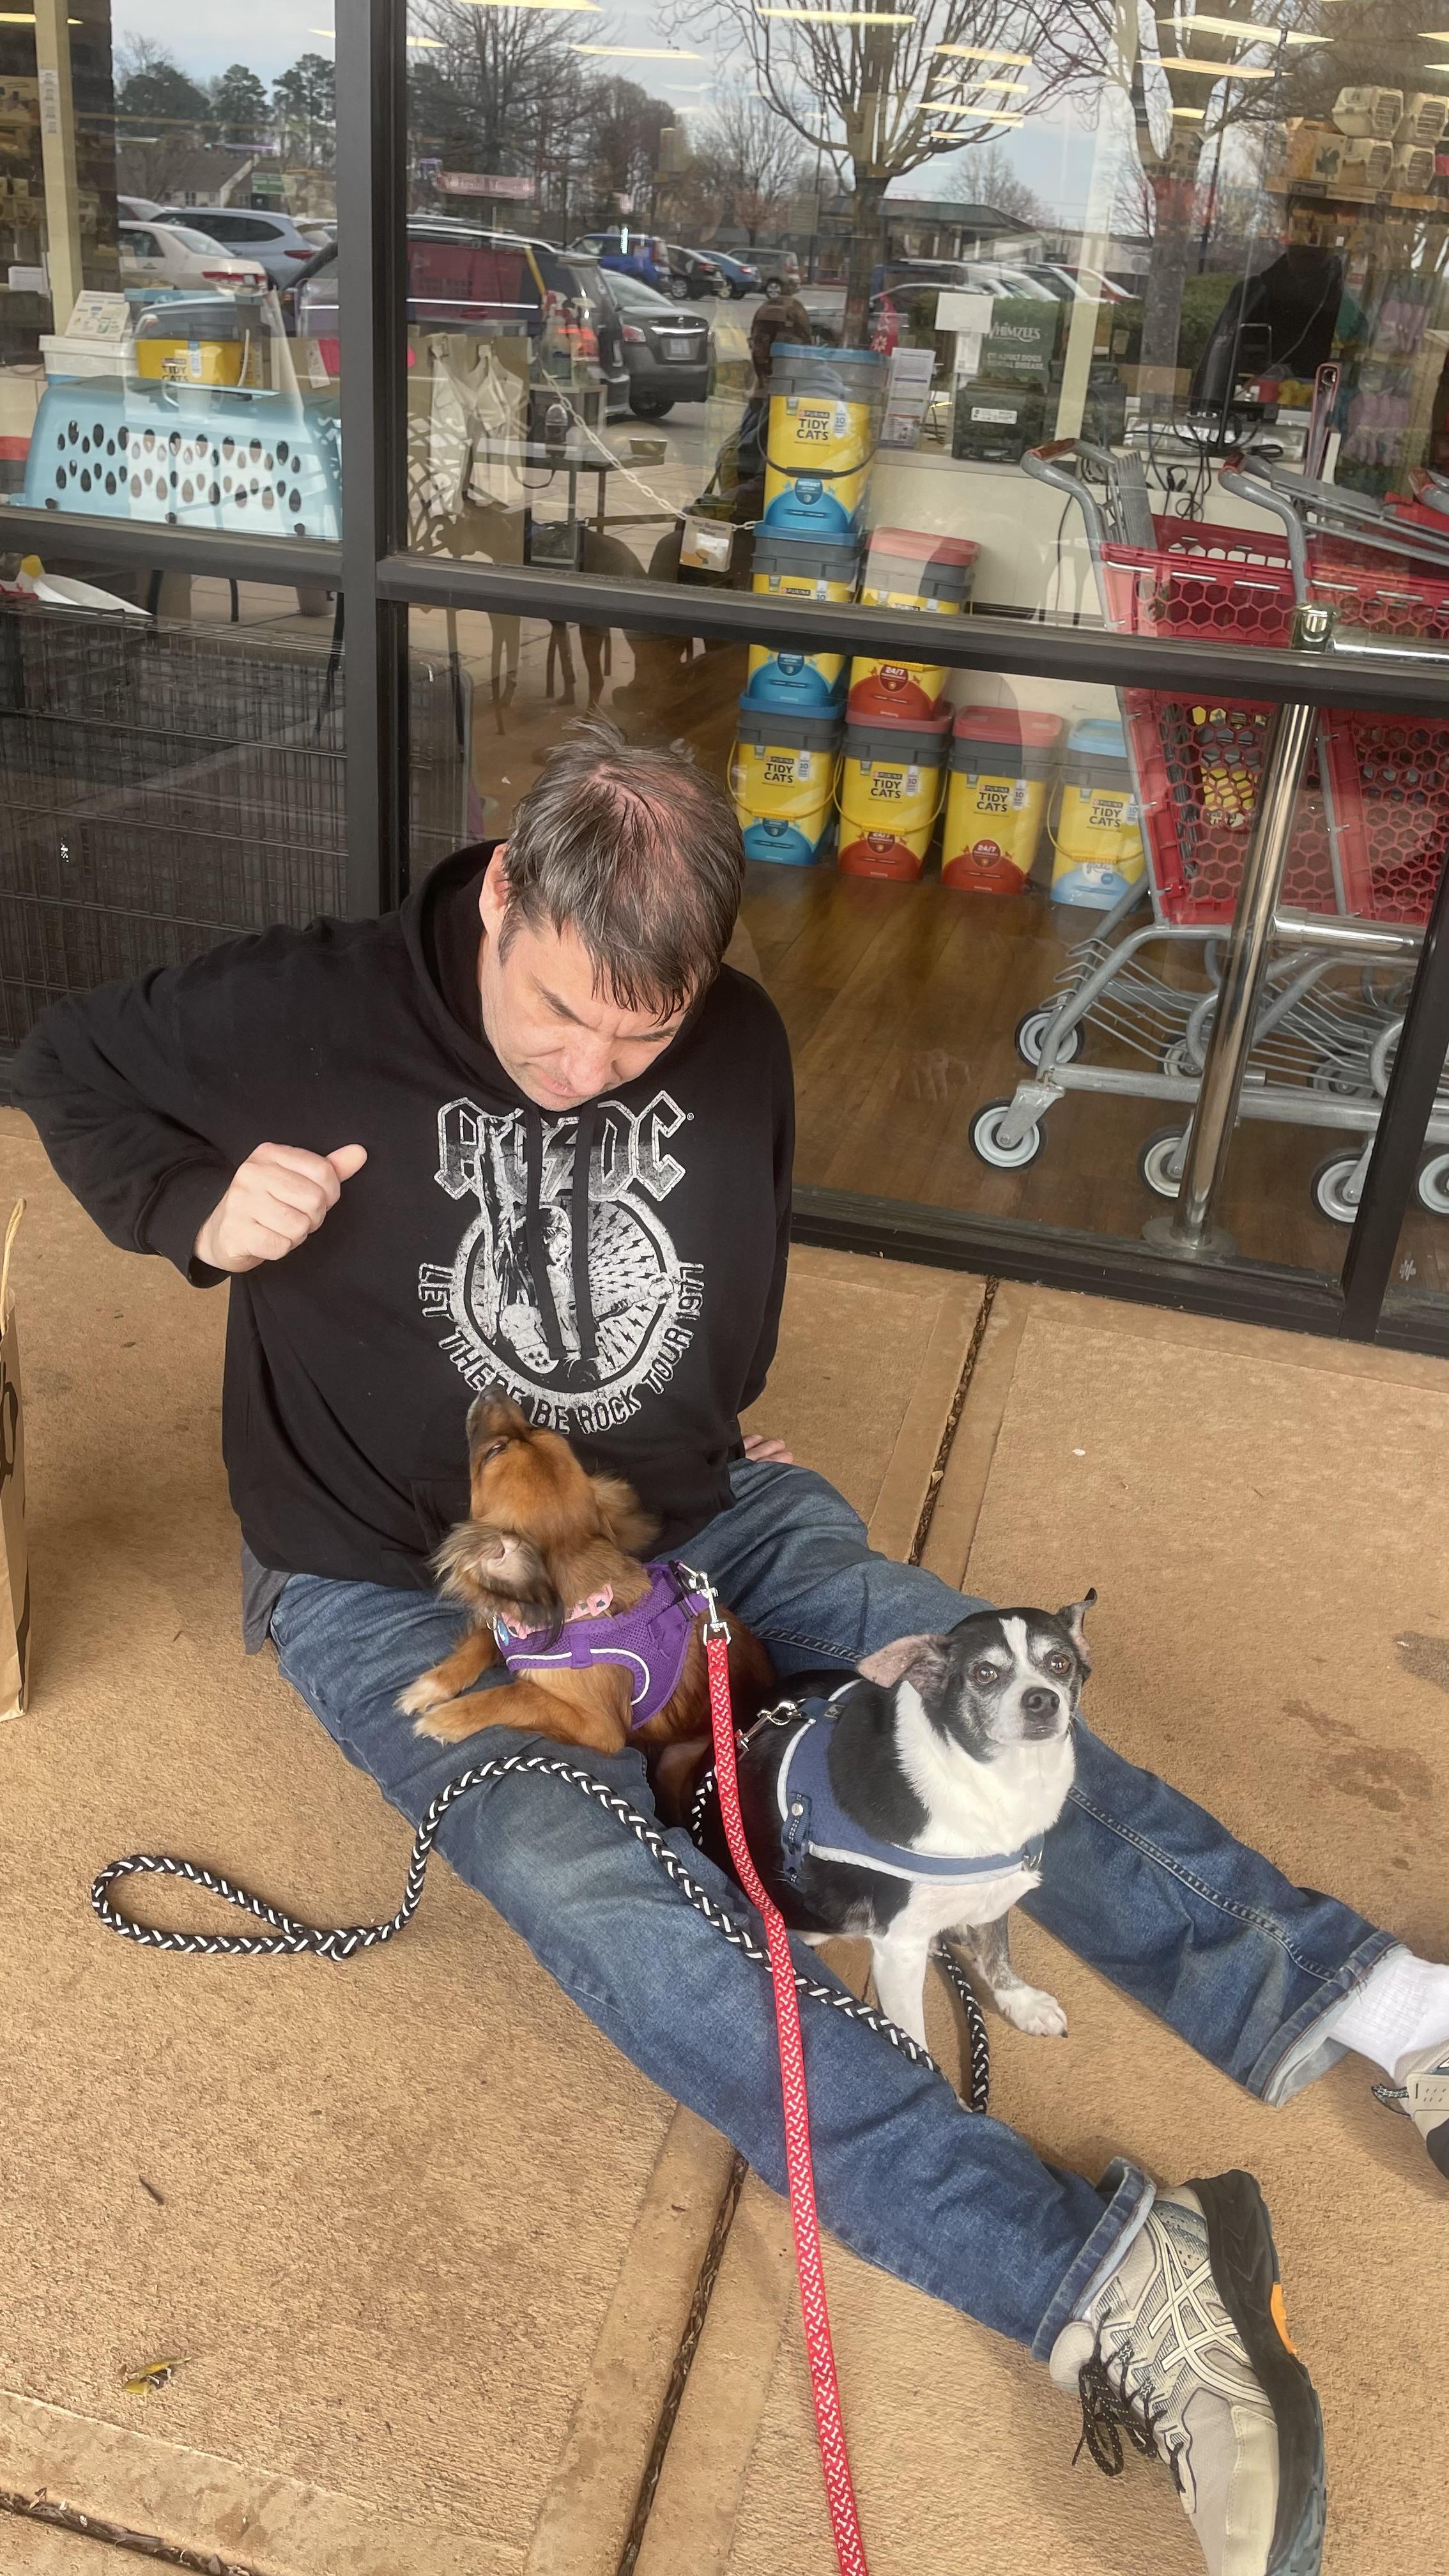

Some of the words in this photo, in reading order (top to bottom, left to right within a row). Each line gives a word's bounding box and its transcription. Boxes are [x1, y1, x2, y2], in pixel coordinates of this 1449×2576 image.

[162, 365, 187, 375] TIDY
[799, 418, 829, 431] TIDY
[797, 429, 829, 441] CATS
[885, 666, 905, 676] 24/7
[765, 763, 793, 774] TIDY
[764, 772, 794, 784] CATS
[873, 778, 901, 790] TIDY
[870, 788, 901, 799] CATS
[979, 792, 1008, 804] TIDY
[976, 801, 1008, 813] CATS
[1092, 806, 1122, 818] TIDY
[1089, 815, 1121, 829] CATS
[977, 844, 997, 852] 24/7
[418, 1263, 456, 1322] LET
[530, 1398, 570, 1435] BE
[576, 1385, 641, 1435] ROCK
[641, 1328, 694, 1395] TOUR
[675, 1262, 704, 1321] 1977
